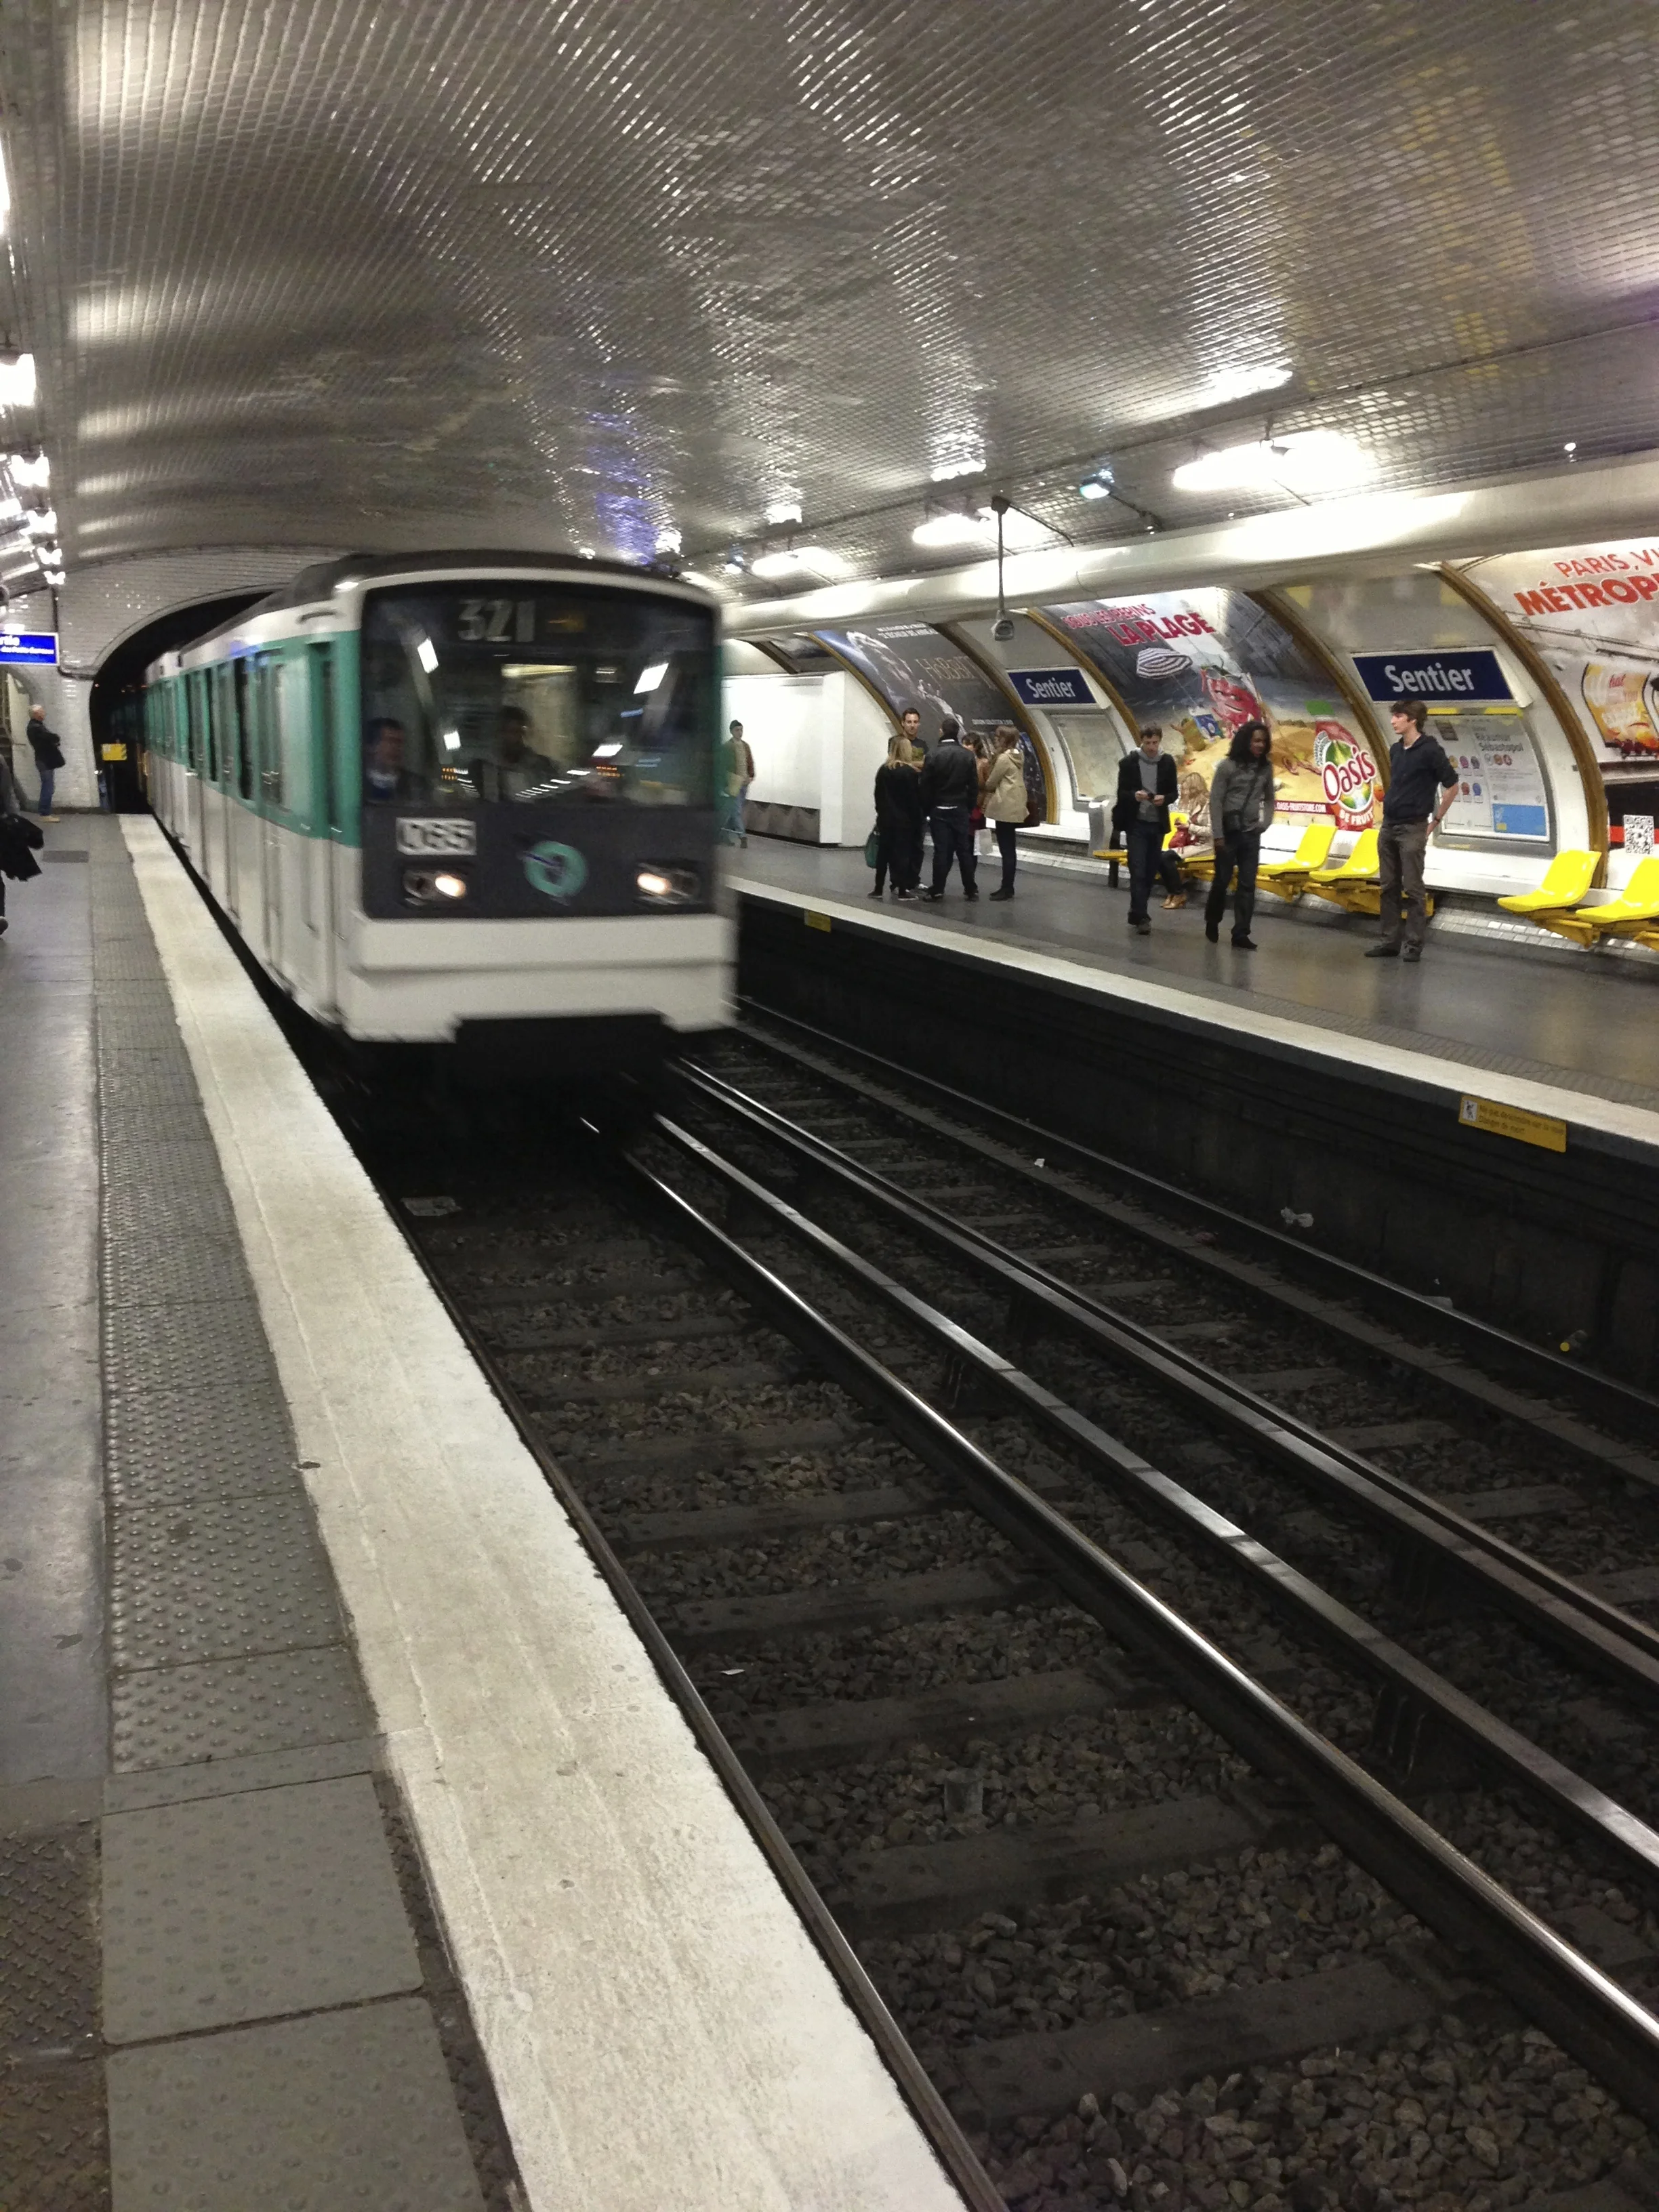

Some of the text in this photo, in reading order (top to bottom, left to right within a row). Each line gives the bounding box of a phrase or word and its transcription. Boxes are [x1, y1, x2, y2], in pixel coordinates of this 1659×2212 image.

[1554, 547, 1659, 577] PARIS, VI
[1105, 612, 1216, 647] LA PLAGE
[1026, 677, 1076, 698] Sentier
[1385, 662, 1475, 693] Sentier
[1323, 745, 1376, 804] Oasis
[1351, 806, 1374, 825] FRUIT
